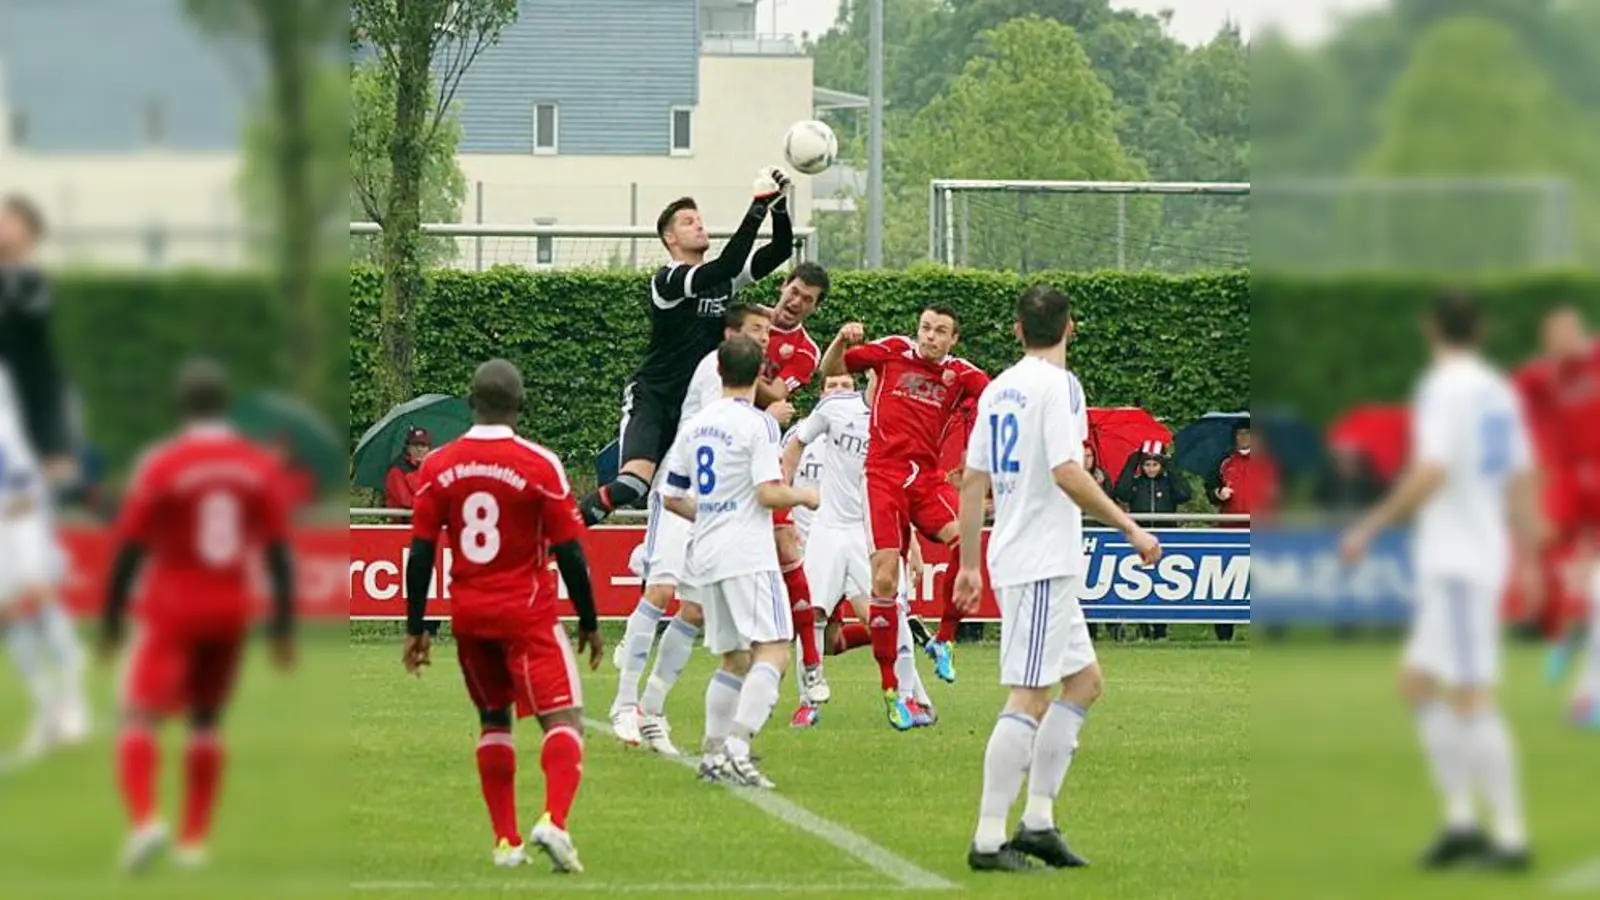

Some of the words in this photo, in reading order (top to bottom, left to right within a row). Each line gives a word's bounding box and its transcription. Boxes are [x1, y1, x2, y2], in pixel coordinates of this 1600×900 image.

[989, 412, 1020, 474] 12
[437, 467, 455, 488] SV
[697, 445, 716, 495] 8
[460, 491, 500, 565] 8
[1079, 554, 1250, 601] USSM
